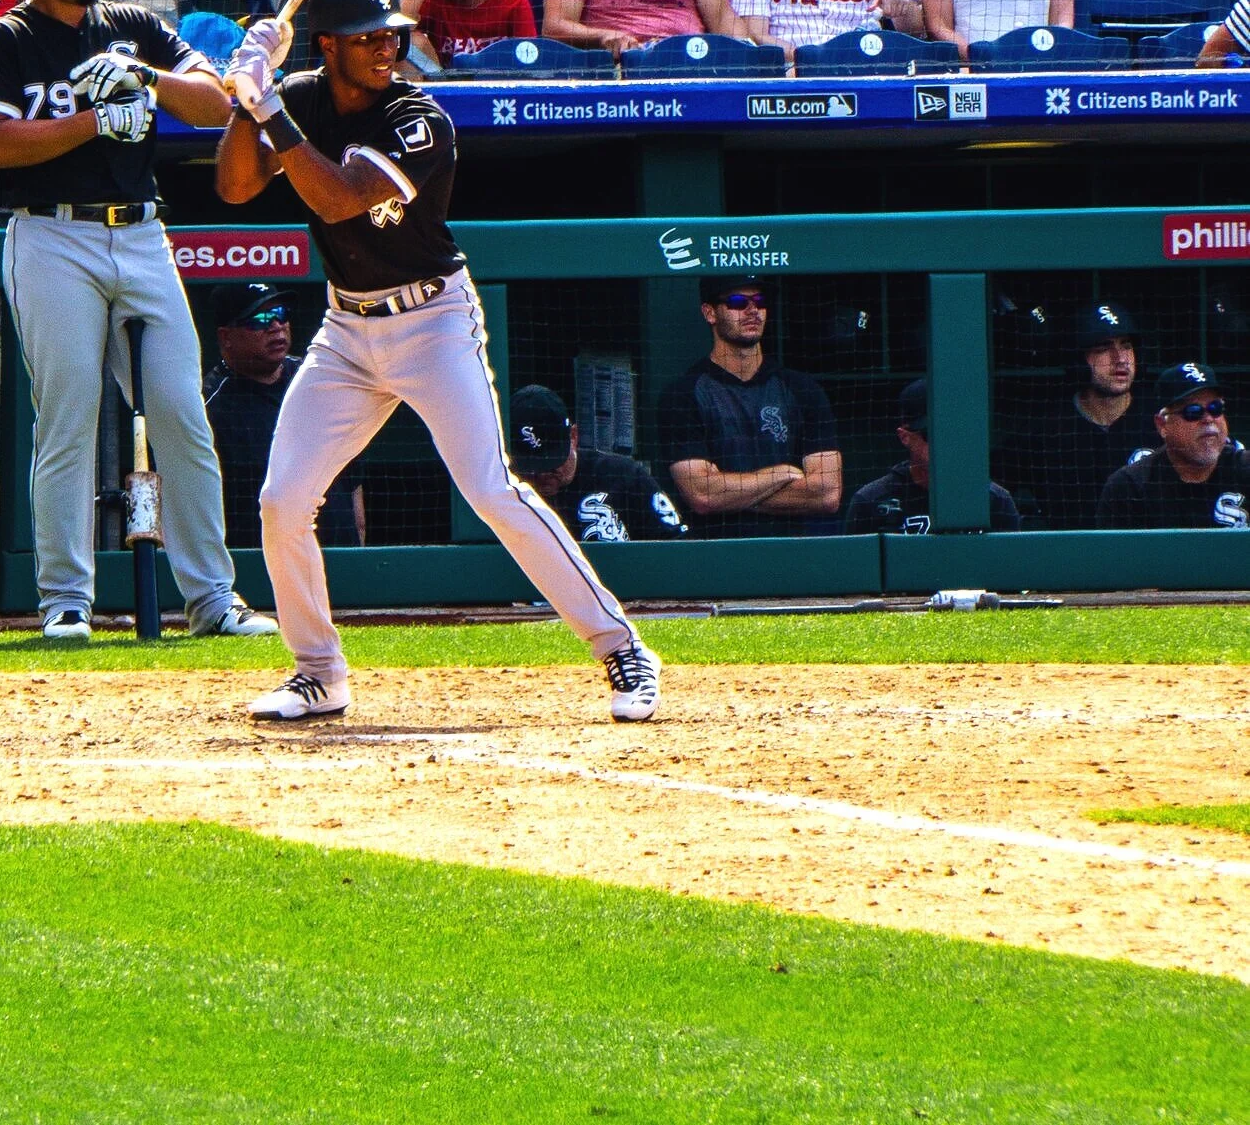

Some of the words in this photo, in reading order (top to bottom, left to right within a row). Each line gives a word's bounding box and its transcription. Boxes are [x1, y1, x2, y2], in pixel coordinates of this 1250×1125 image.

[24, 80, 78, 121] 79
[954, 91, 981, 103] NEW
[954, 102, 981, 113] ERA
[1077, 90, 1147, 110] Citizens
[1151, 90, 1195, 108] Bank
[1198, 89, 1238, 108] Park
[523, 102, 594, 122] Citizens
[596, 101, 641, 119] Bank
[644, 99, 683, 118] Park
[752, 99, 825, 117] MLB.com
[710, 234, 770, 250] ENERGY
[1172, 221, 1250, 256] philli
[170, 240, 301, 269] es.com
[710, 251, 790, 267] TRANSFER
[1097, 305, 1120, 325] Sox
[1182, 361, 1206, 382] Sox
[760, 405, 788, 443] Sox
[521, 425, 542, 448] Sox
